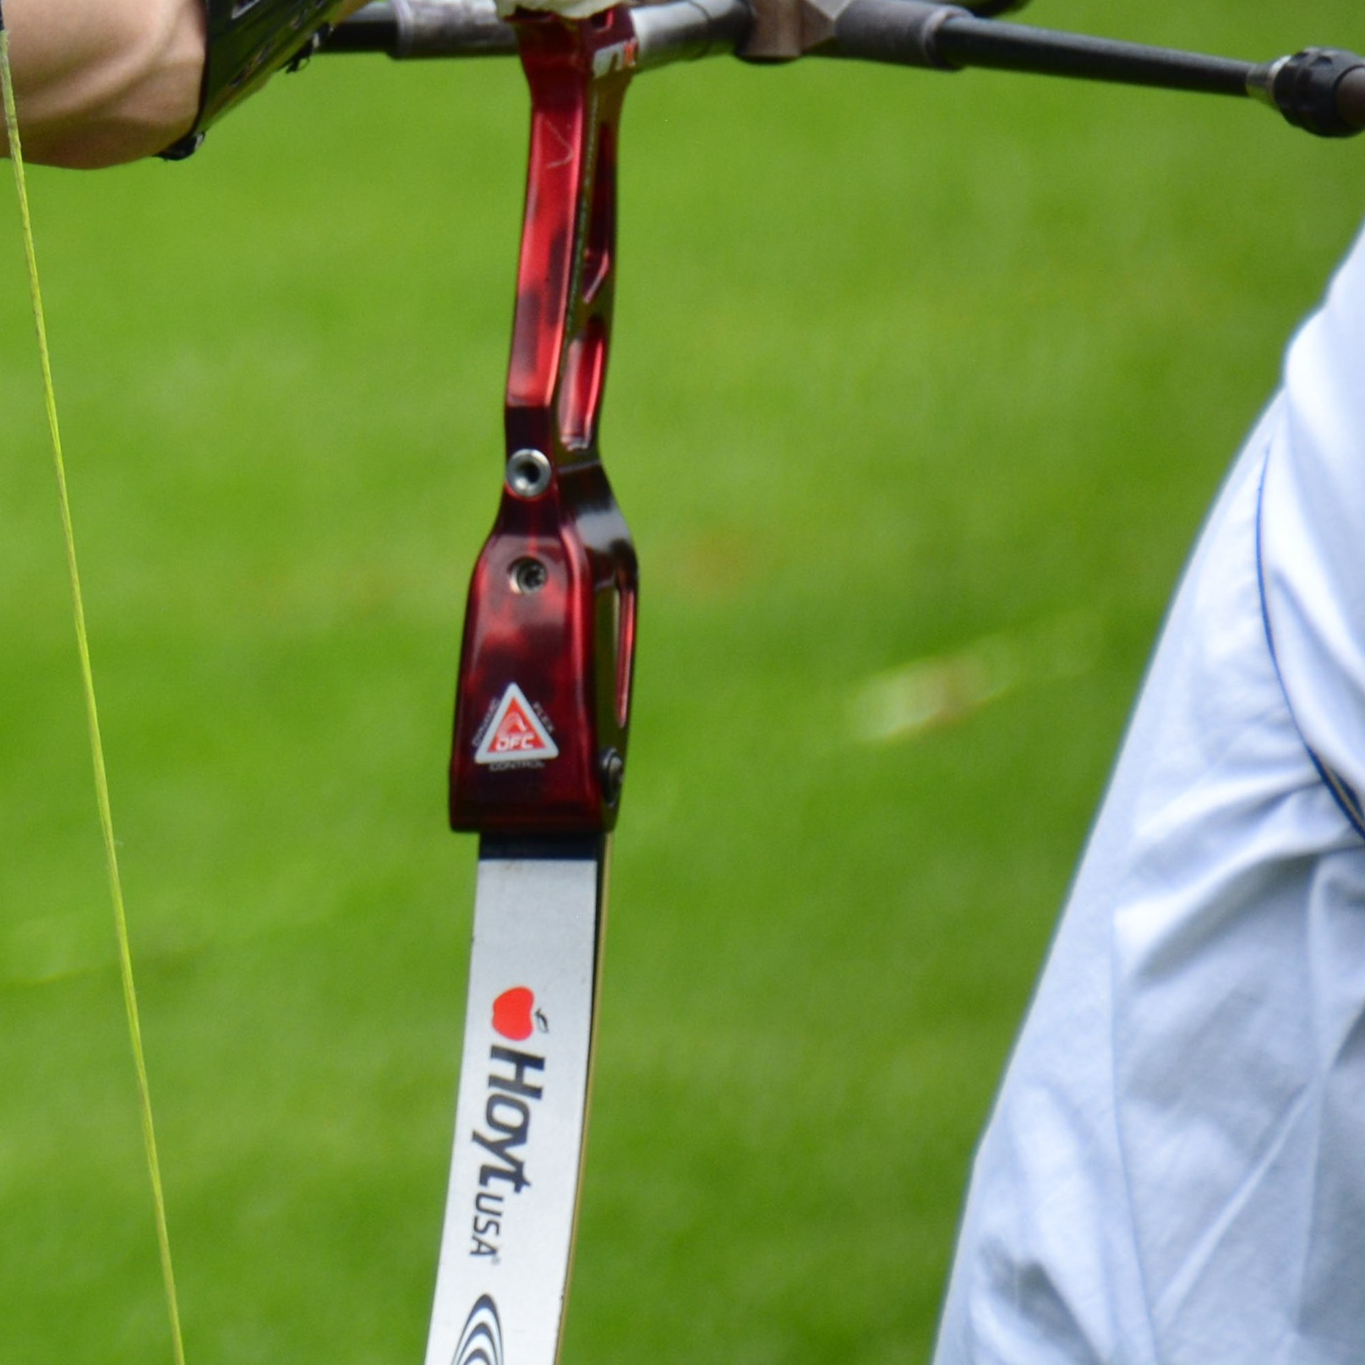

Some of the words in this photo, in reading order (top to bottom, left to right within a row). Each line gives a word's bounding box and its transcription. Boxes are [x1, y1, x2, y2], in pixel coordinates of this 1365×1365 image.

[496, 734, 535, 751] DFC
[471, 1045, 545, 1194] Hoyt
[470, 1192, 504, 1257] USA
